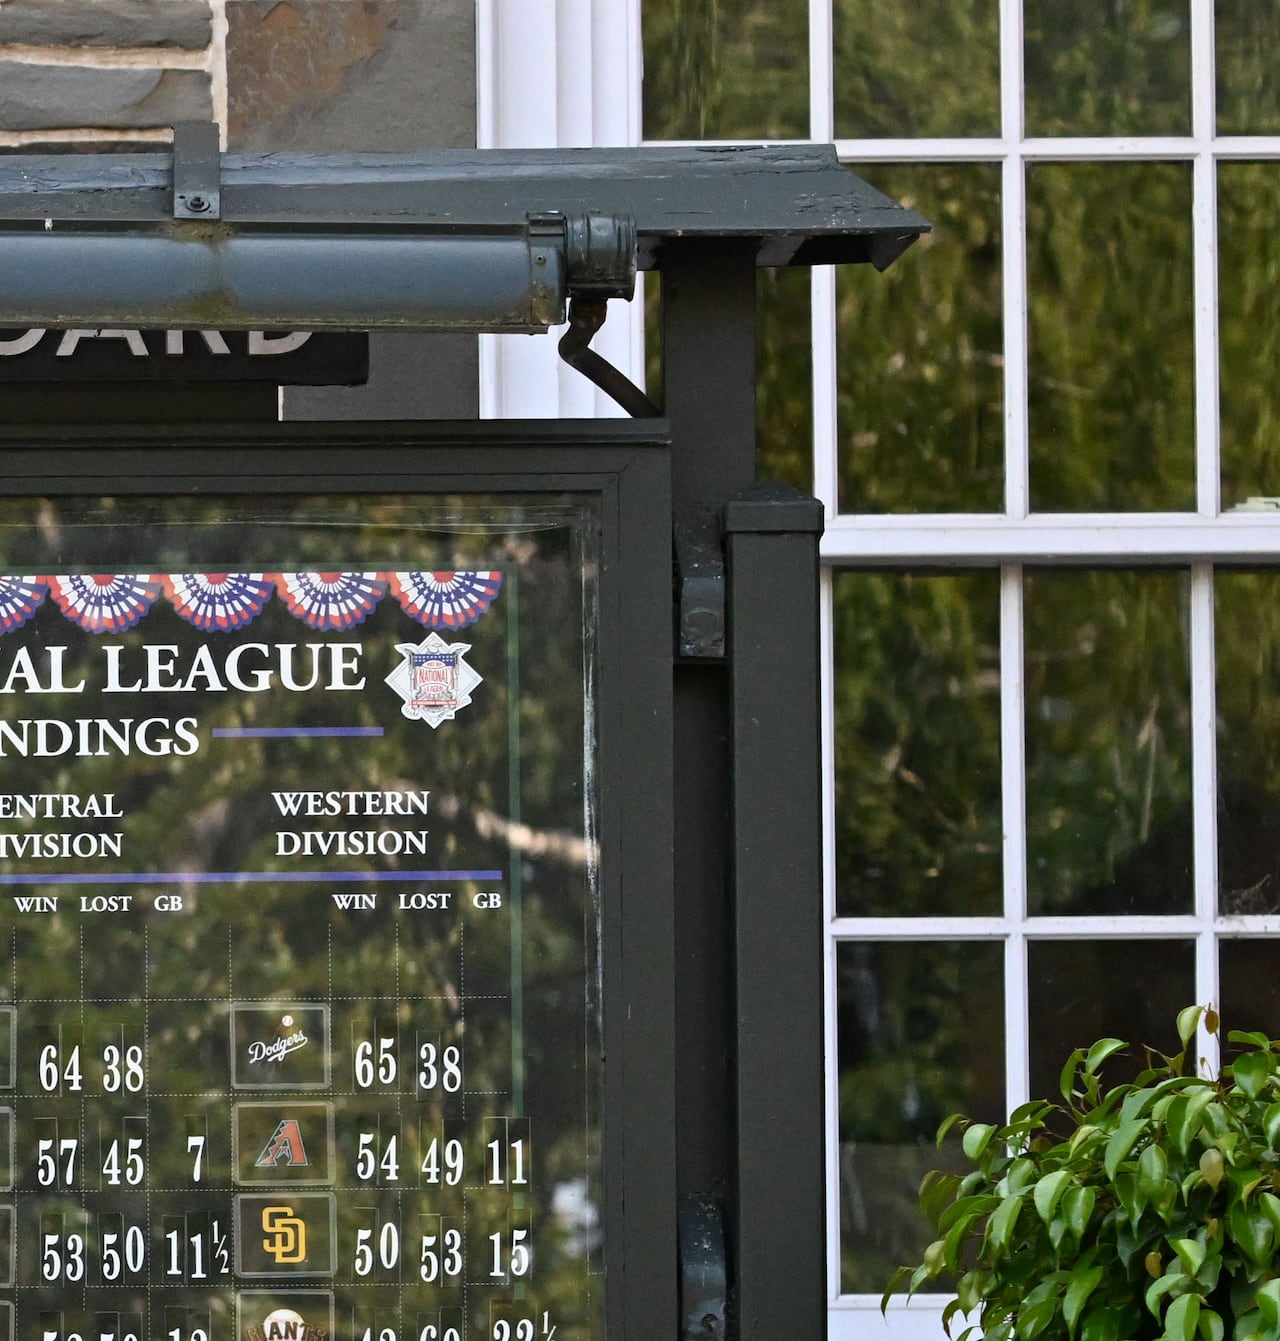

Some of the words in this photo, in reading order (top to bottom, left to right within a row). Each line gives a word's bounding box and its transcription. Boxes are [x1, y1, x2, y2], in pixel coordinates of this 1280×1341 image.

[101, 643, 366, 693] LEAGUE
[271, 790, 430, 817] WESTERN
[275, 830, 429, 856] DIVISION
[13, 896, 58, 913] WIN
[80, 895, 133, 912] LOST
[153, 895, 183, 912] GB
[332, 894, 377, 910] WIN
[399, 893, 451, 910] LOST
[472, 892, 502, 909] GB
[39, 1044, 83, 1091] 64
[103, 1045, 144, 1092] 38
[248, 1030, 308, 1063] Dodgers
[355, 1037, 397, 1088] 65
[419, 1042, 462, 1093] 38
[37, 1139, 78, 1186] 57
[102, 1138, 144, 1185] 45
[187, 1136, 205, 1182] 7
[357, 1133, 400, 1181] 54
[421, 1137, 464, 1186] 49
[487, 1139, 527, 1185] 11
[43, 1234, 84, 1282] 53
[102, 1225, 145, 1280] 50
[354, 1222, 399, 1276] 50
[420, 1229, 463, 1283] 53
[489, 1229, 530, 1277] 15
